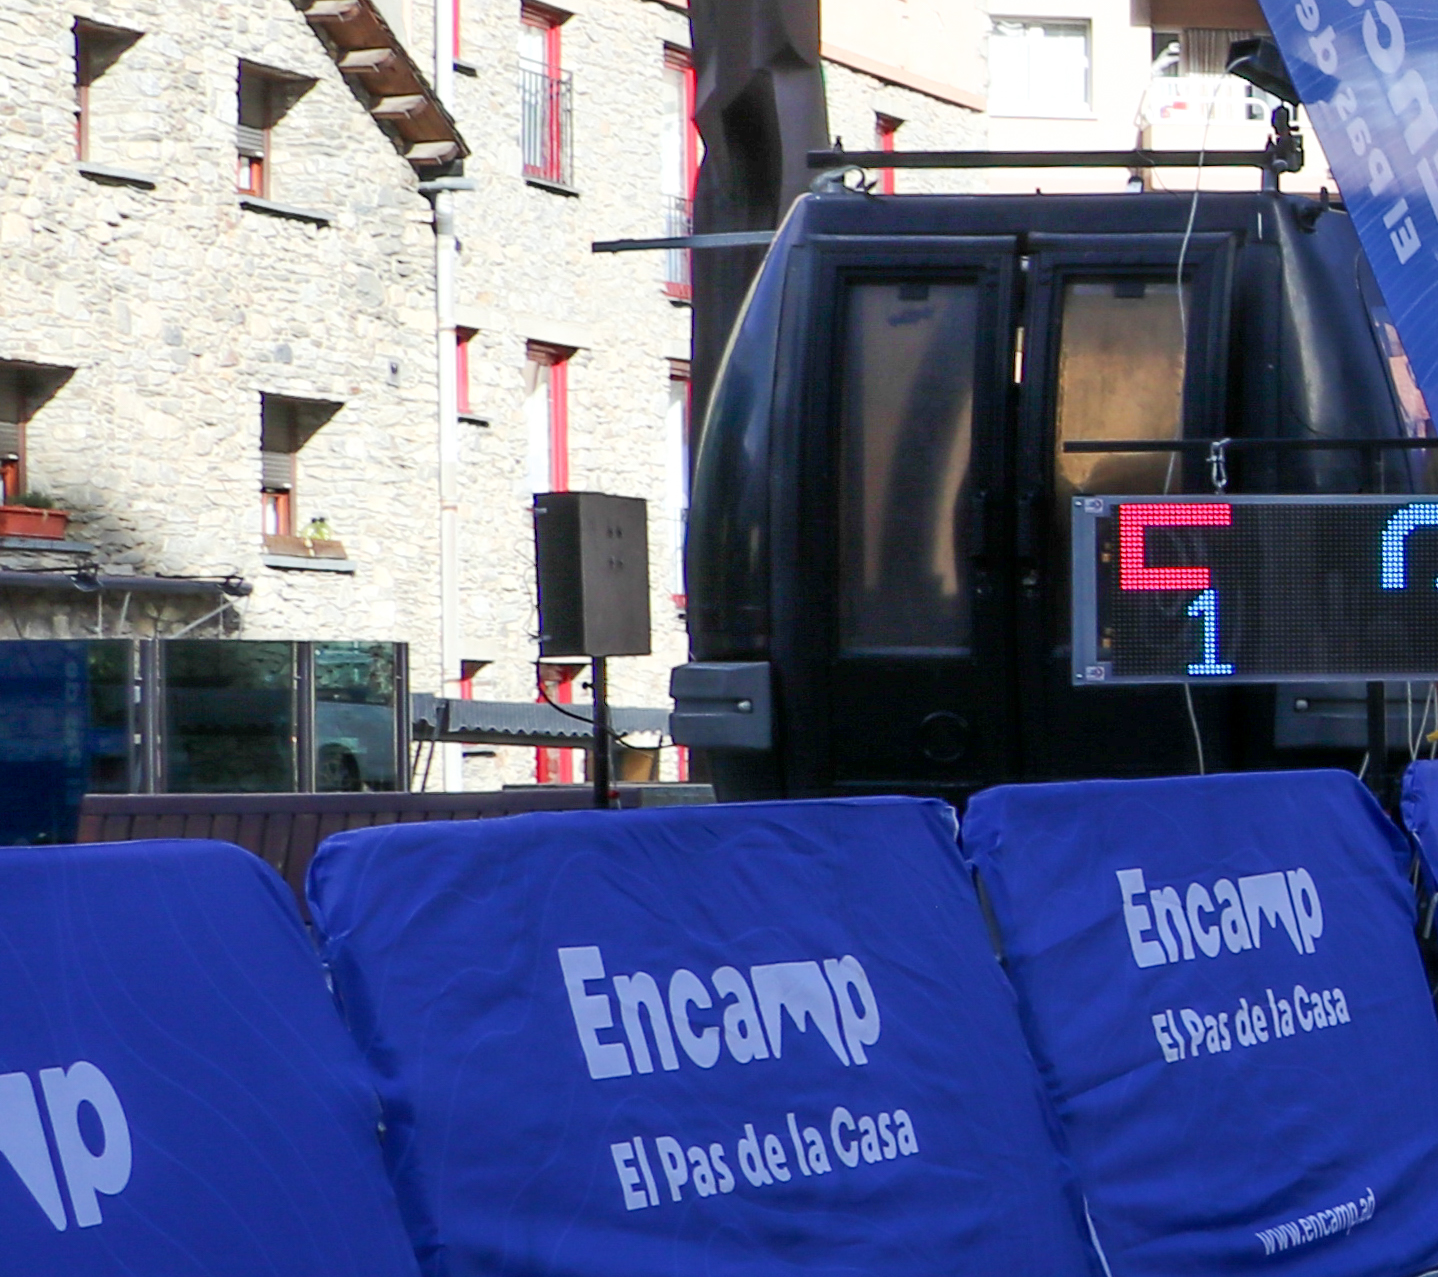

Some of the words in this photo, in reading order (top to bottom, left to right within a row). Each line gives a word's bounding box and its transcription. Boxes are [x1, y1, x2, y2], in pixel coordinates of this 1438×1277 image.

[1115, 867, 1323, 968] Encamp
[558, 945, 881, 1080] Encamp
[1151, 1009, 1186, 1063] El
[1179, 1007, 1232, 1057] Pas
[1236, 997, 1269, 1048] de
[1266, 988, 1295, 1039] la
[1293, 983, 1351, 1033] Casa
[610, 1136, 660, 1211] El
[656, 1135, 736, 1203] Pas
[738, 1123, 791, 1187] de
[786, 1112, 832, 1176] la
[831, 1105, 918, 1168] Casa
[1255, 1186, 1376, 1256] www.encamp.ad
